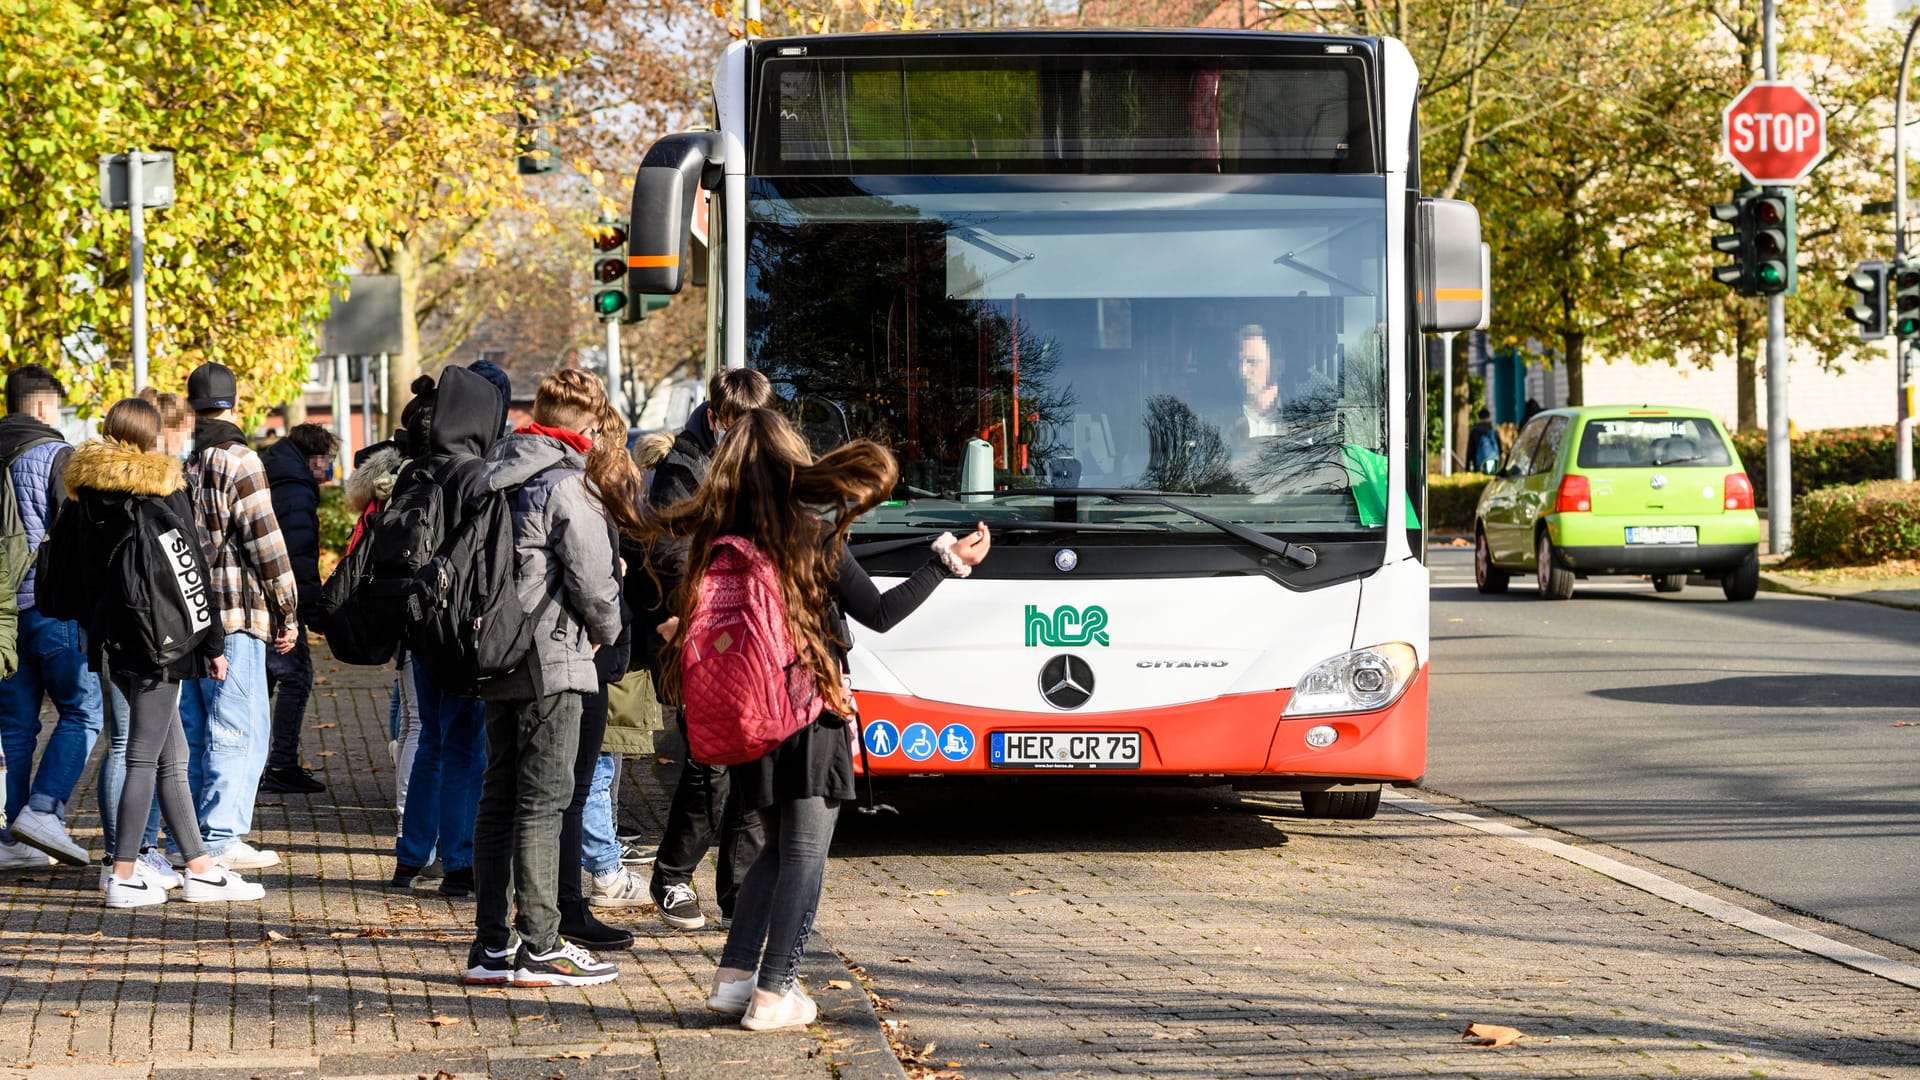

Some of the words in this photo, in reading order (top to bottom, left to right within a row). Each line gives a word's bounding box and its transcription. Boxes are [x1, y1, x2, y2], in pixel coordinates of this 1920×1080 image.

[1733, 112, 1815, 153] STOP
[171, 536, 210, 622] adidas
[1136, 659, 1229, 669] CITARO
[1007, 736, 1054, 759] HER
[1070, 736, 1100, 760] CR
[1106, 737, 1136, 760] 75
